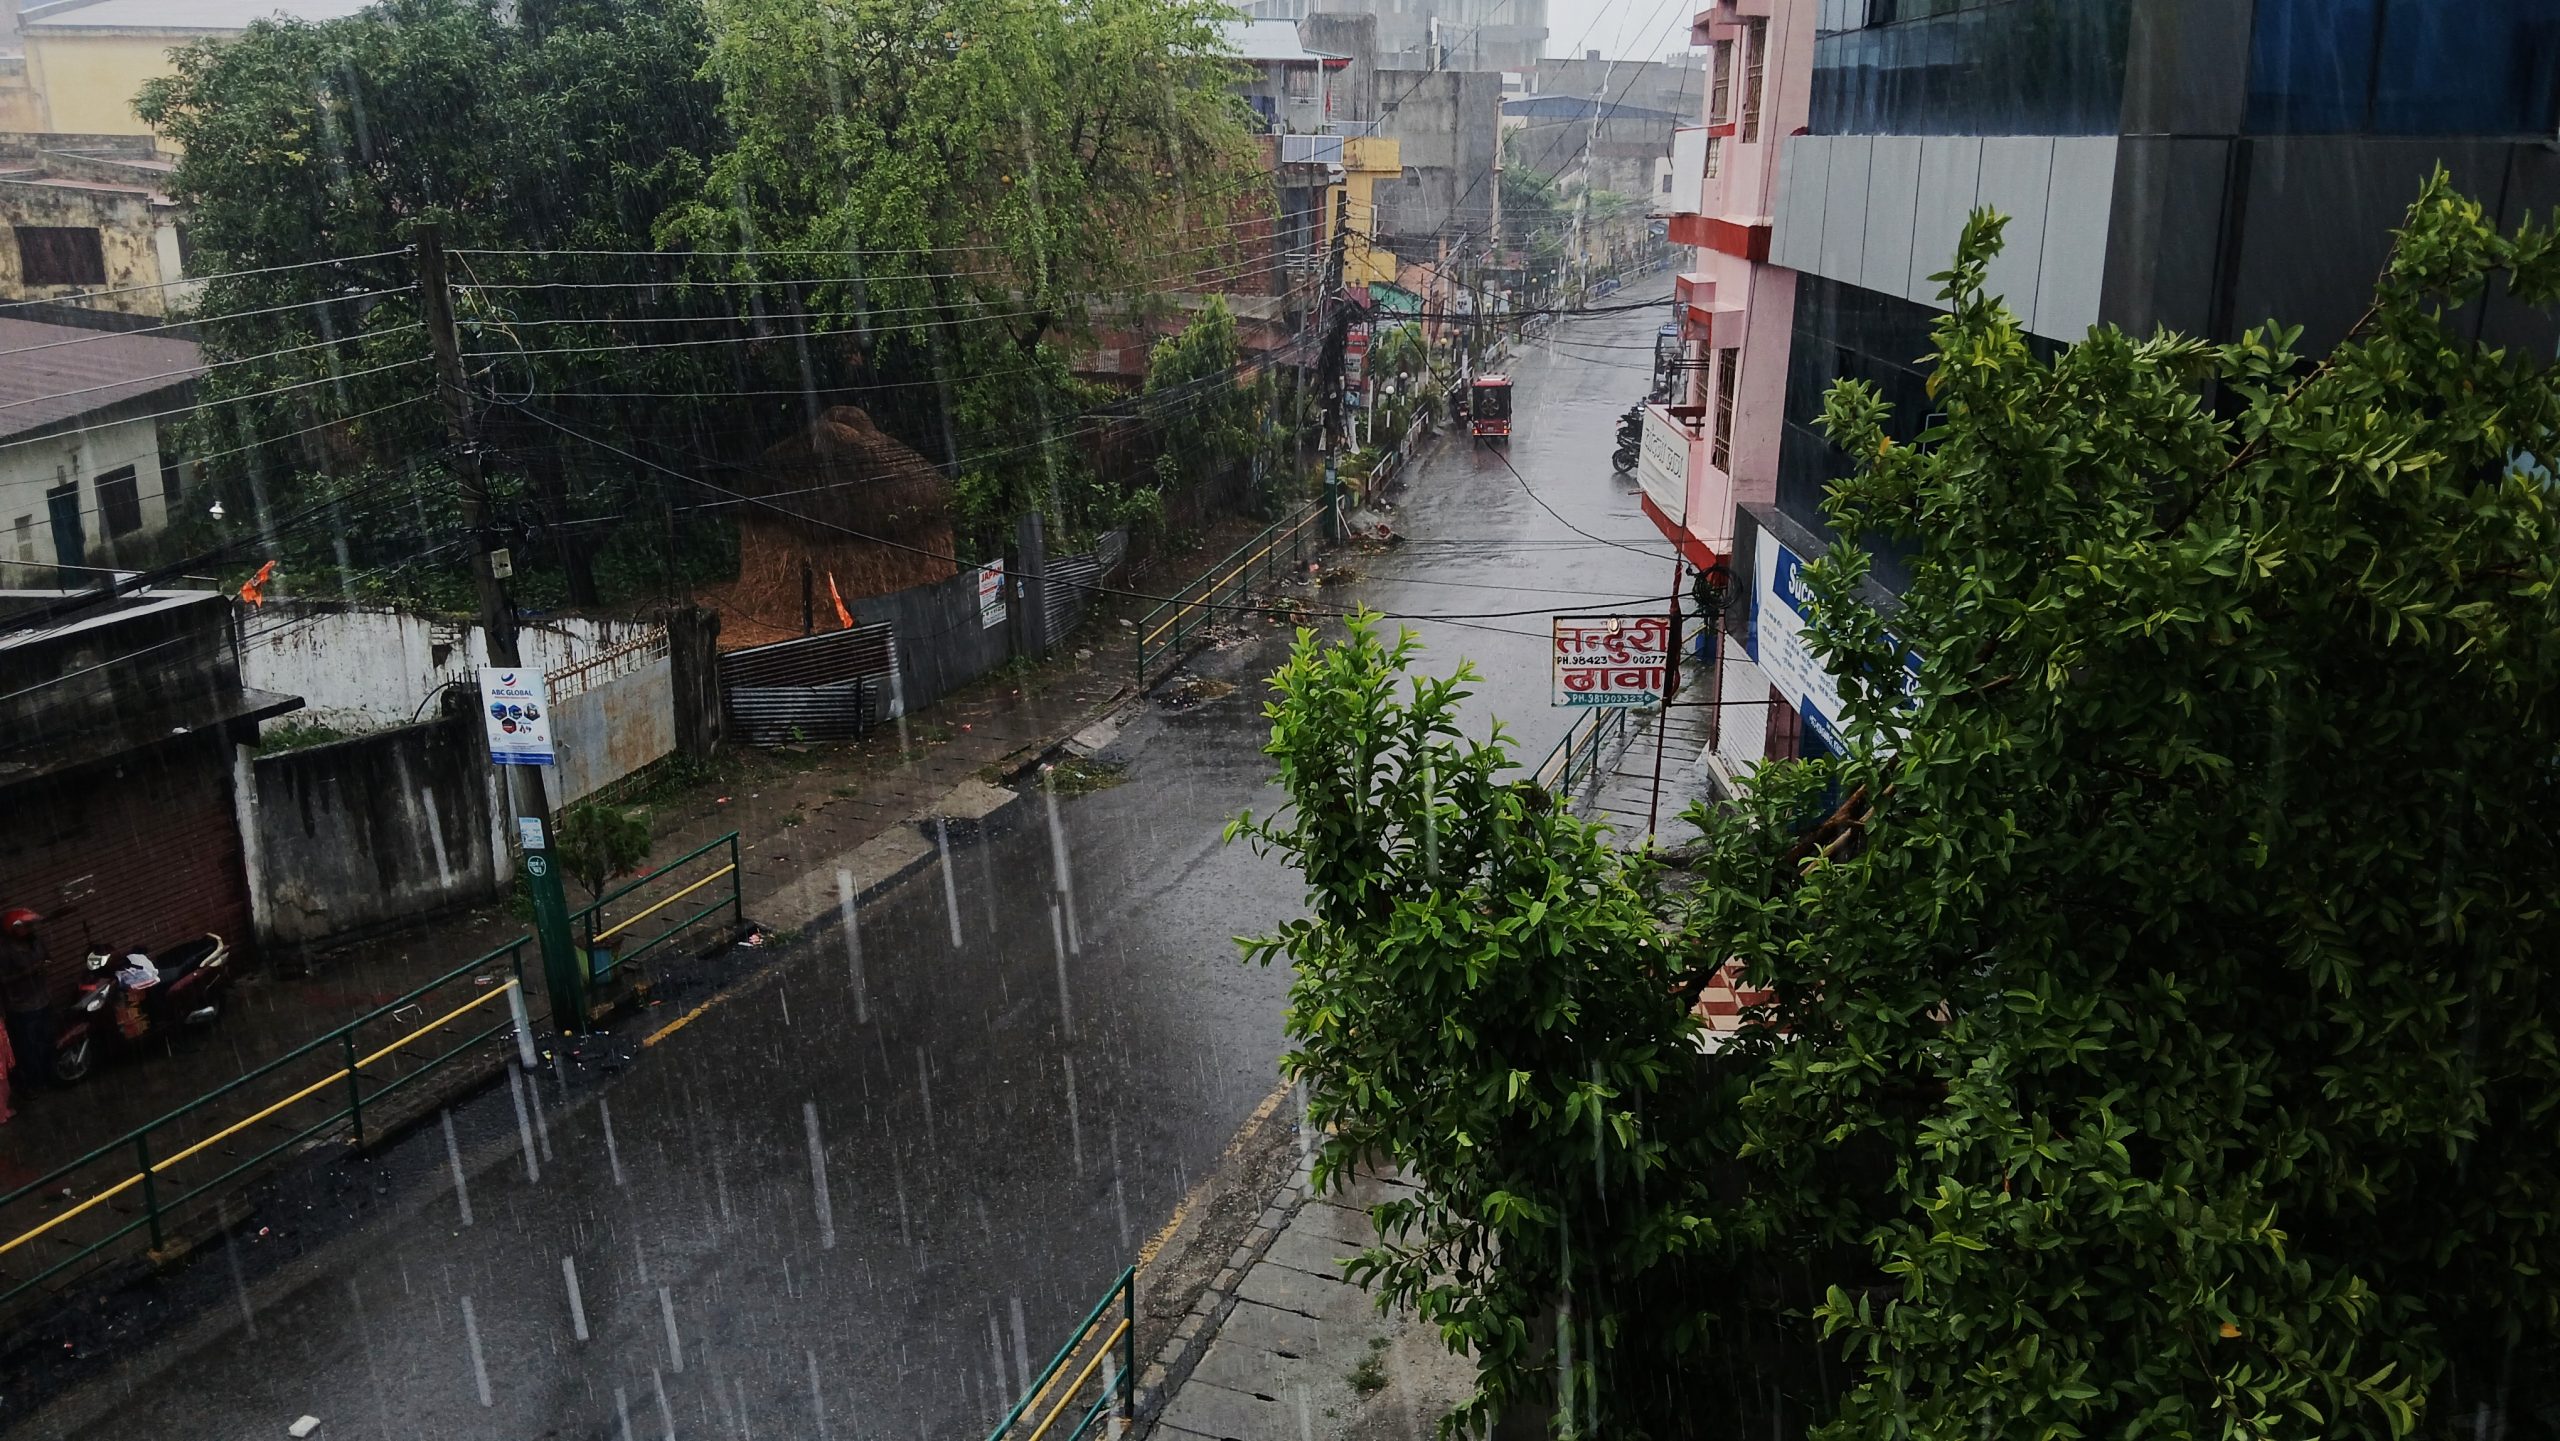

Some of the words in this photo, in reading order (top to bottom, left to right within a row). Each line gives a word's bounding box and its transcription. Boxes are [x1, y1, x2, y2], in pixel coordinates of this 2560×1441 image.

[981, 565, 1002, 583] JAPAN
[1557, 656, 1608, 665] PH.98423
[1633, 655, 1667, 665] 00277
[506, 689, 533, 697] GLOBAL
